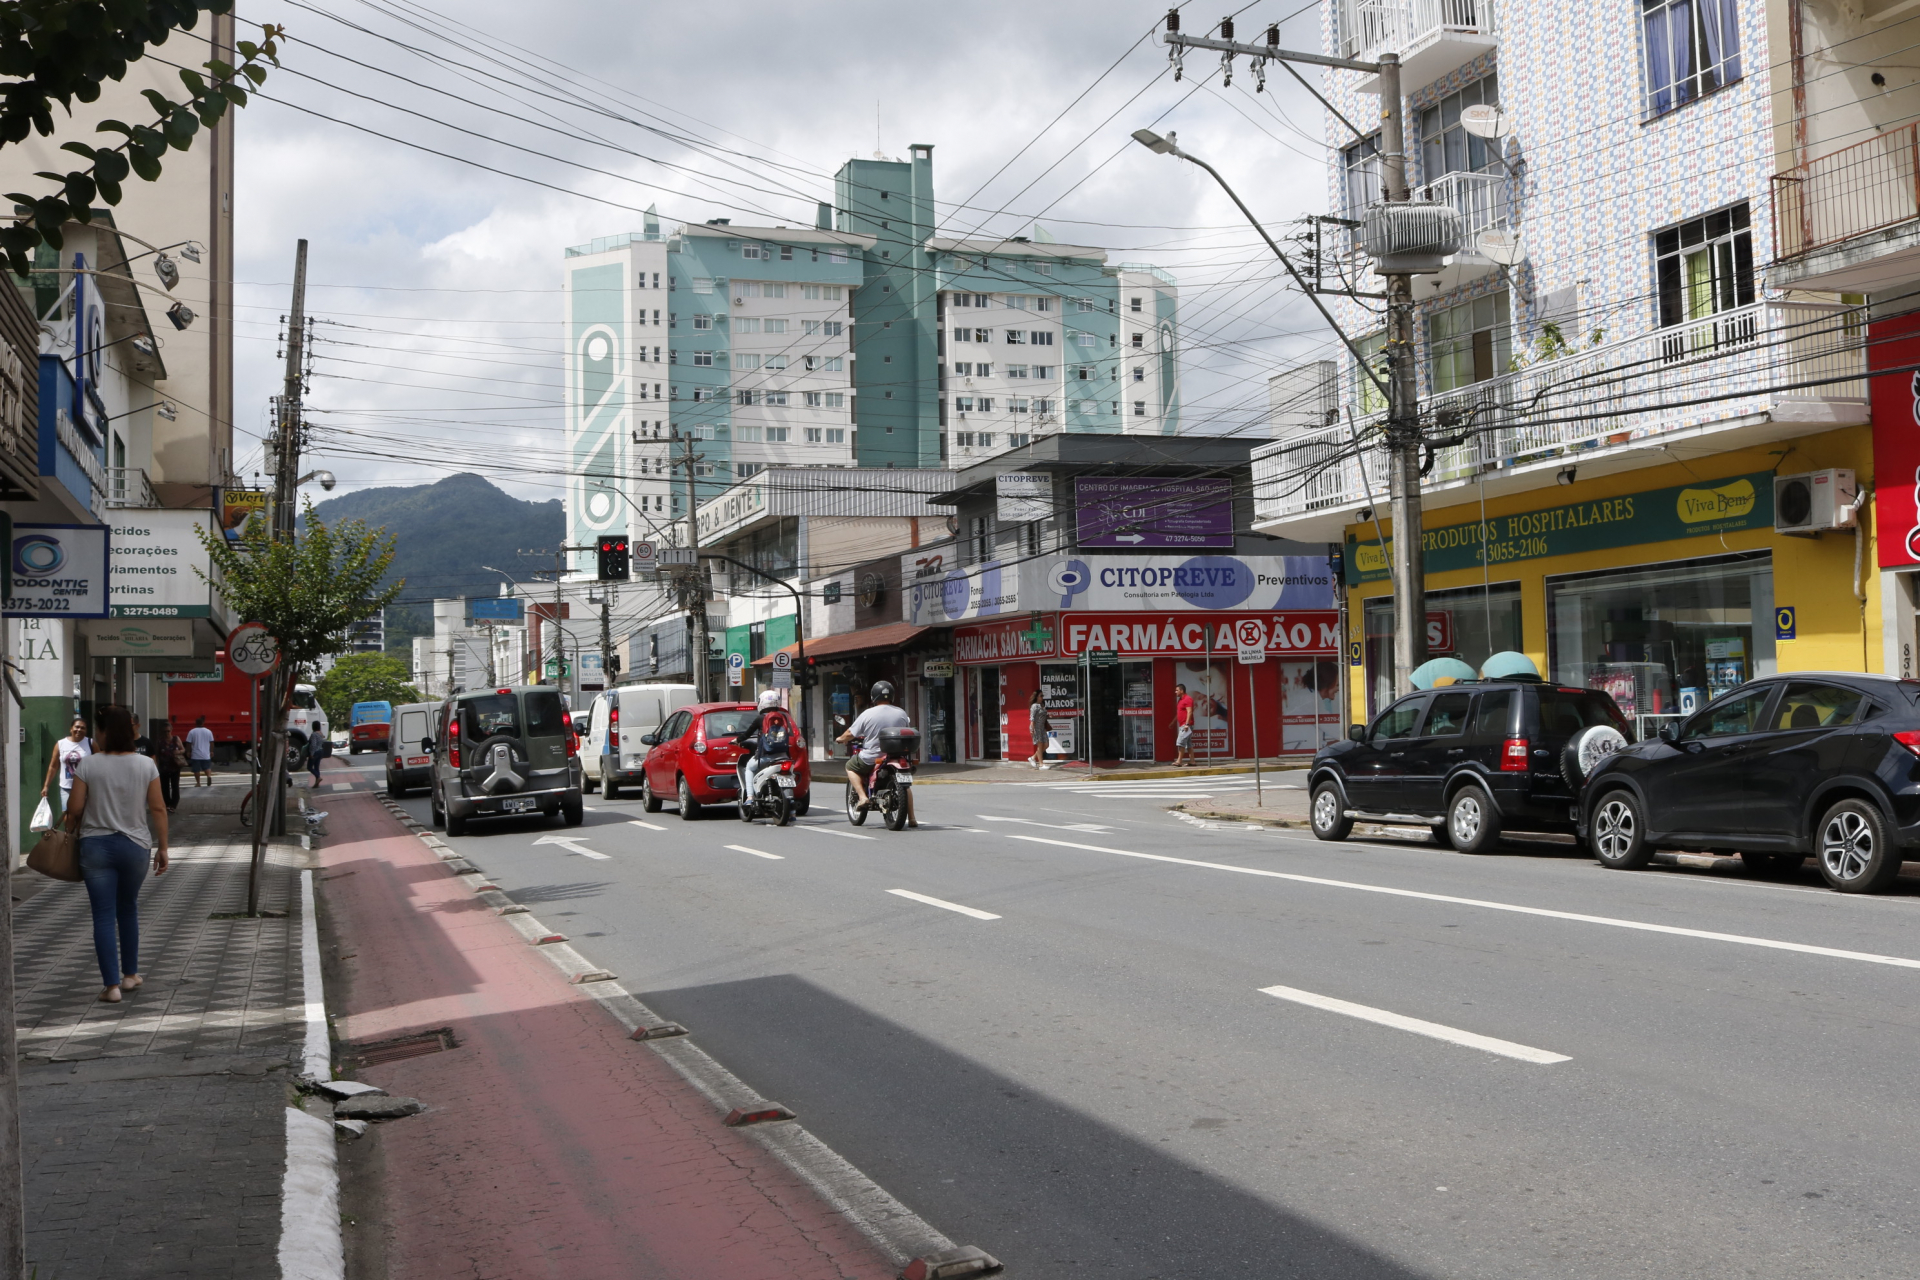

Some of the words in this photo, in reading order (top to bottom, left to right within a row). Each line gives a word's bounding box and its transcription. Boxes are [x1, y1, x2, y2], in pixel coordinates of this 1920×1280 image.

[998, 475, 1050, 483] CITOPREVE
[1079, 484, 1108, 492] CENTRO
[1109, 484, 1120, 492] DE
[714, 508, 720, 527] &
[723, 488, 753, 523] MENTE
[1685, 498, 1715, 516] Viva
[1717, 493, 1747, 512] Bem
[1421, 521, 1497, 551] PRODUTOS
[1508, 497, 1634, 538] HOSPITALARES
[1487, 536, 1548, 562] 3055-2106
[1360, 551, 1378, 566] Viva
[13, 578, 89, 588] ODONTIC
[1100, 567, 1236, 588] CITOPREVE
[1257, 574, 1329, 586] Preventivos
[53, 588, 89, 596] CENTER
[1124, 591, 1160, 599] Consultoria
[1171, 591, 1199, 599] Patologia
[123, 607, 179, 616] 3275-0489
[1069, 617, 1238, 651] FARMÁCA
[955, 629, 998, 660] FARMÁCIA
[1001, 624, 1017, 657] SÃO
[732, 655, 740, 667] P
[779, 655, 786, 665] E
[1043, 673, 1076, 682] FARMÁCIA
[1051, 686, 1067, 696] SÃO
[1044, 699, 1075, 708] MARCOS
